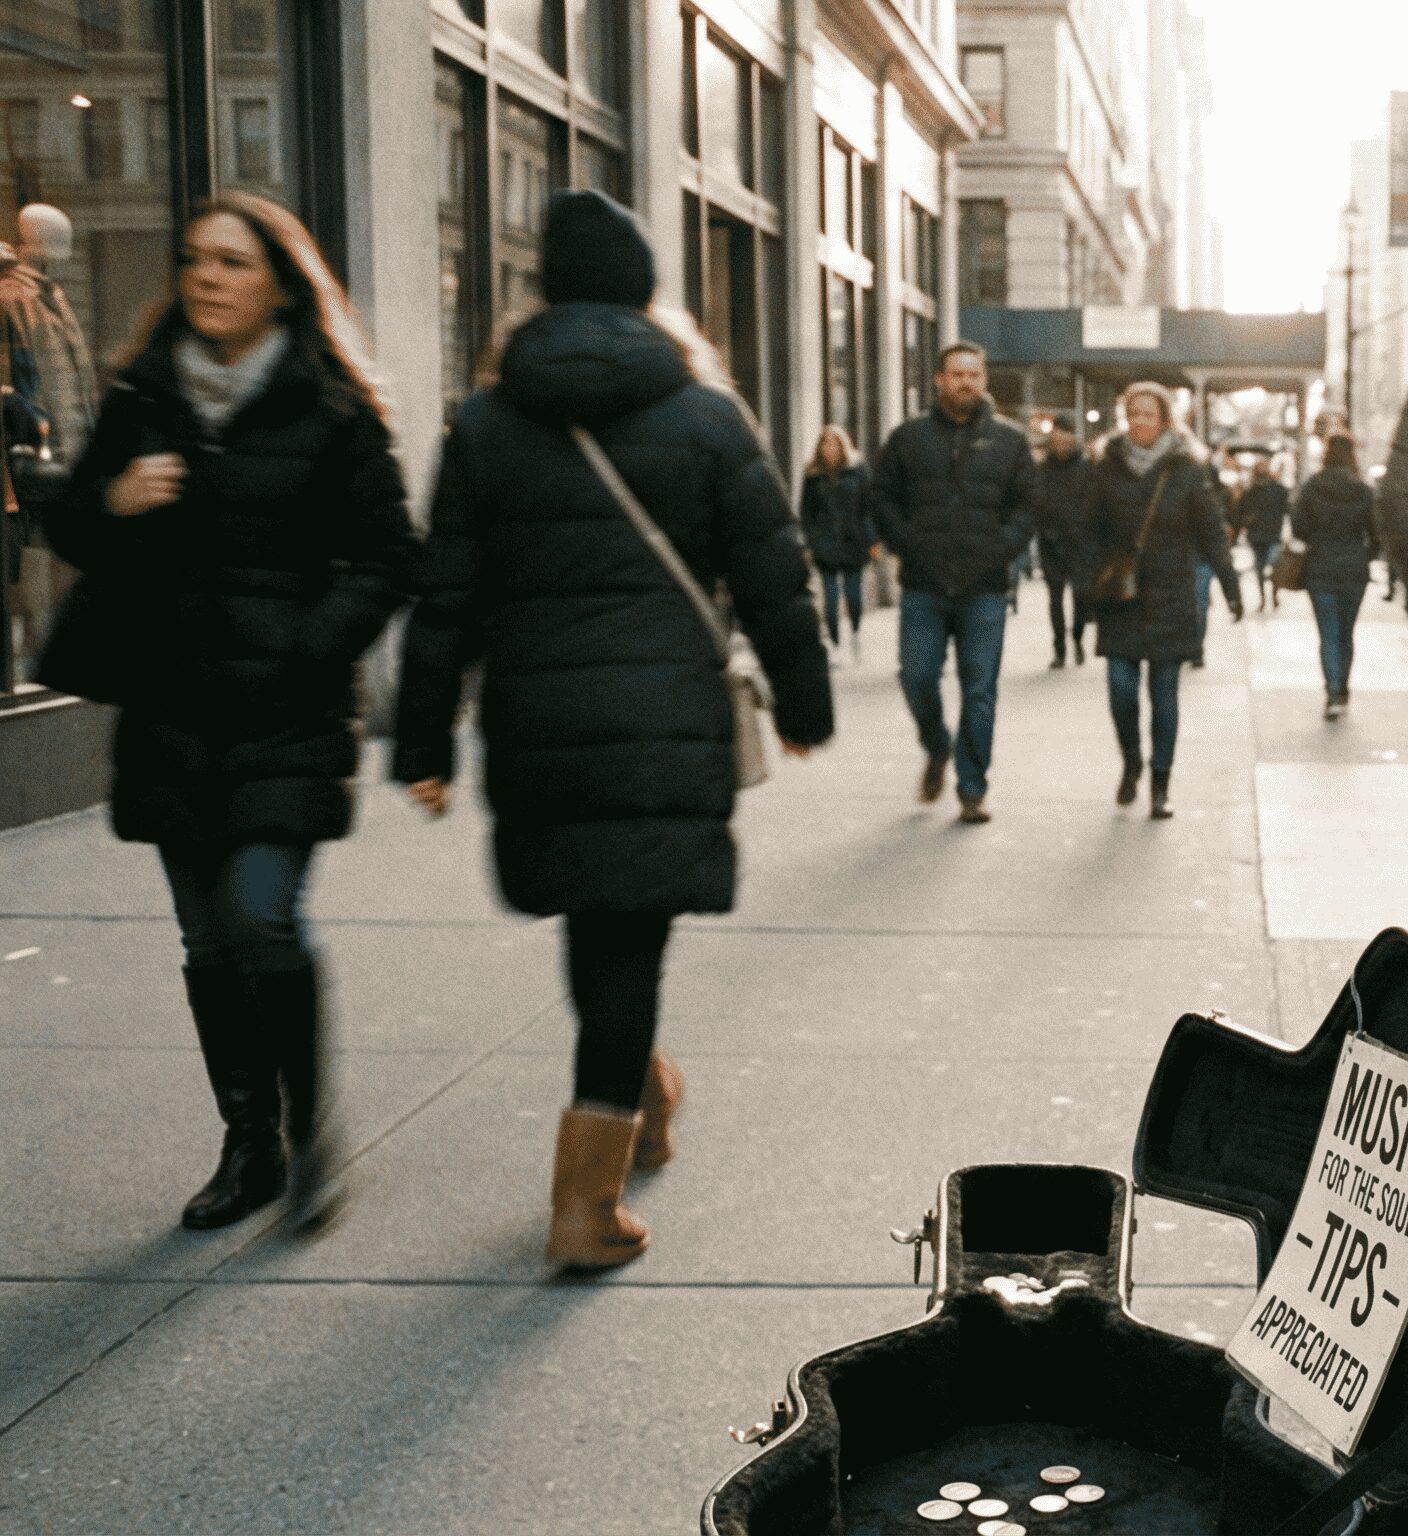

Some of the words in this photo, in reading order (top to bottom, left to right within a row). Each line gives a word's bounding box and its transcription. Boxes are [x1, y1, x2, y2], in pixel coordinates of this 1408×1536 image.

[1318, 1150, 1350, 1195] FOR
[1348, 1166, 1380, 1214] THE
[1251, 1295, 1369, 1413] APPRECIATED
